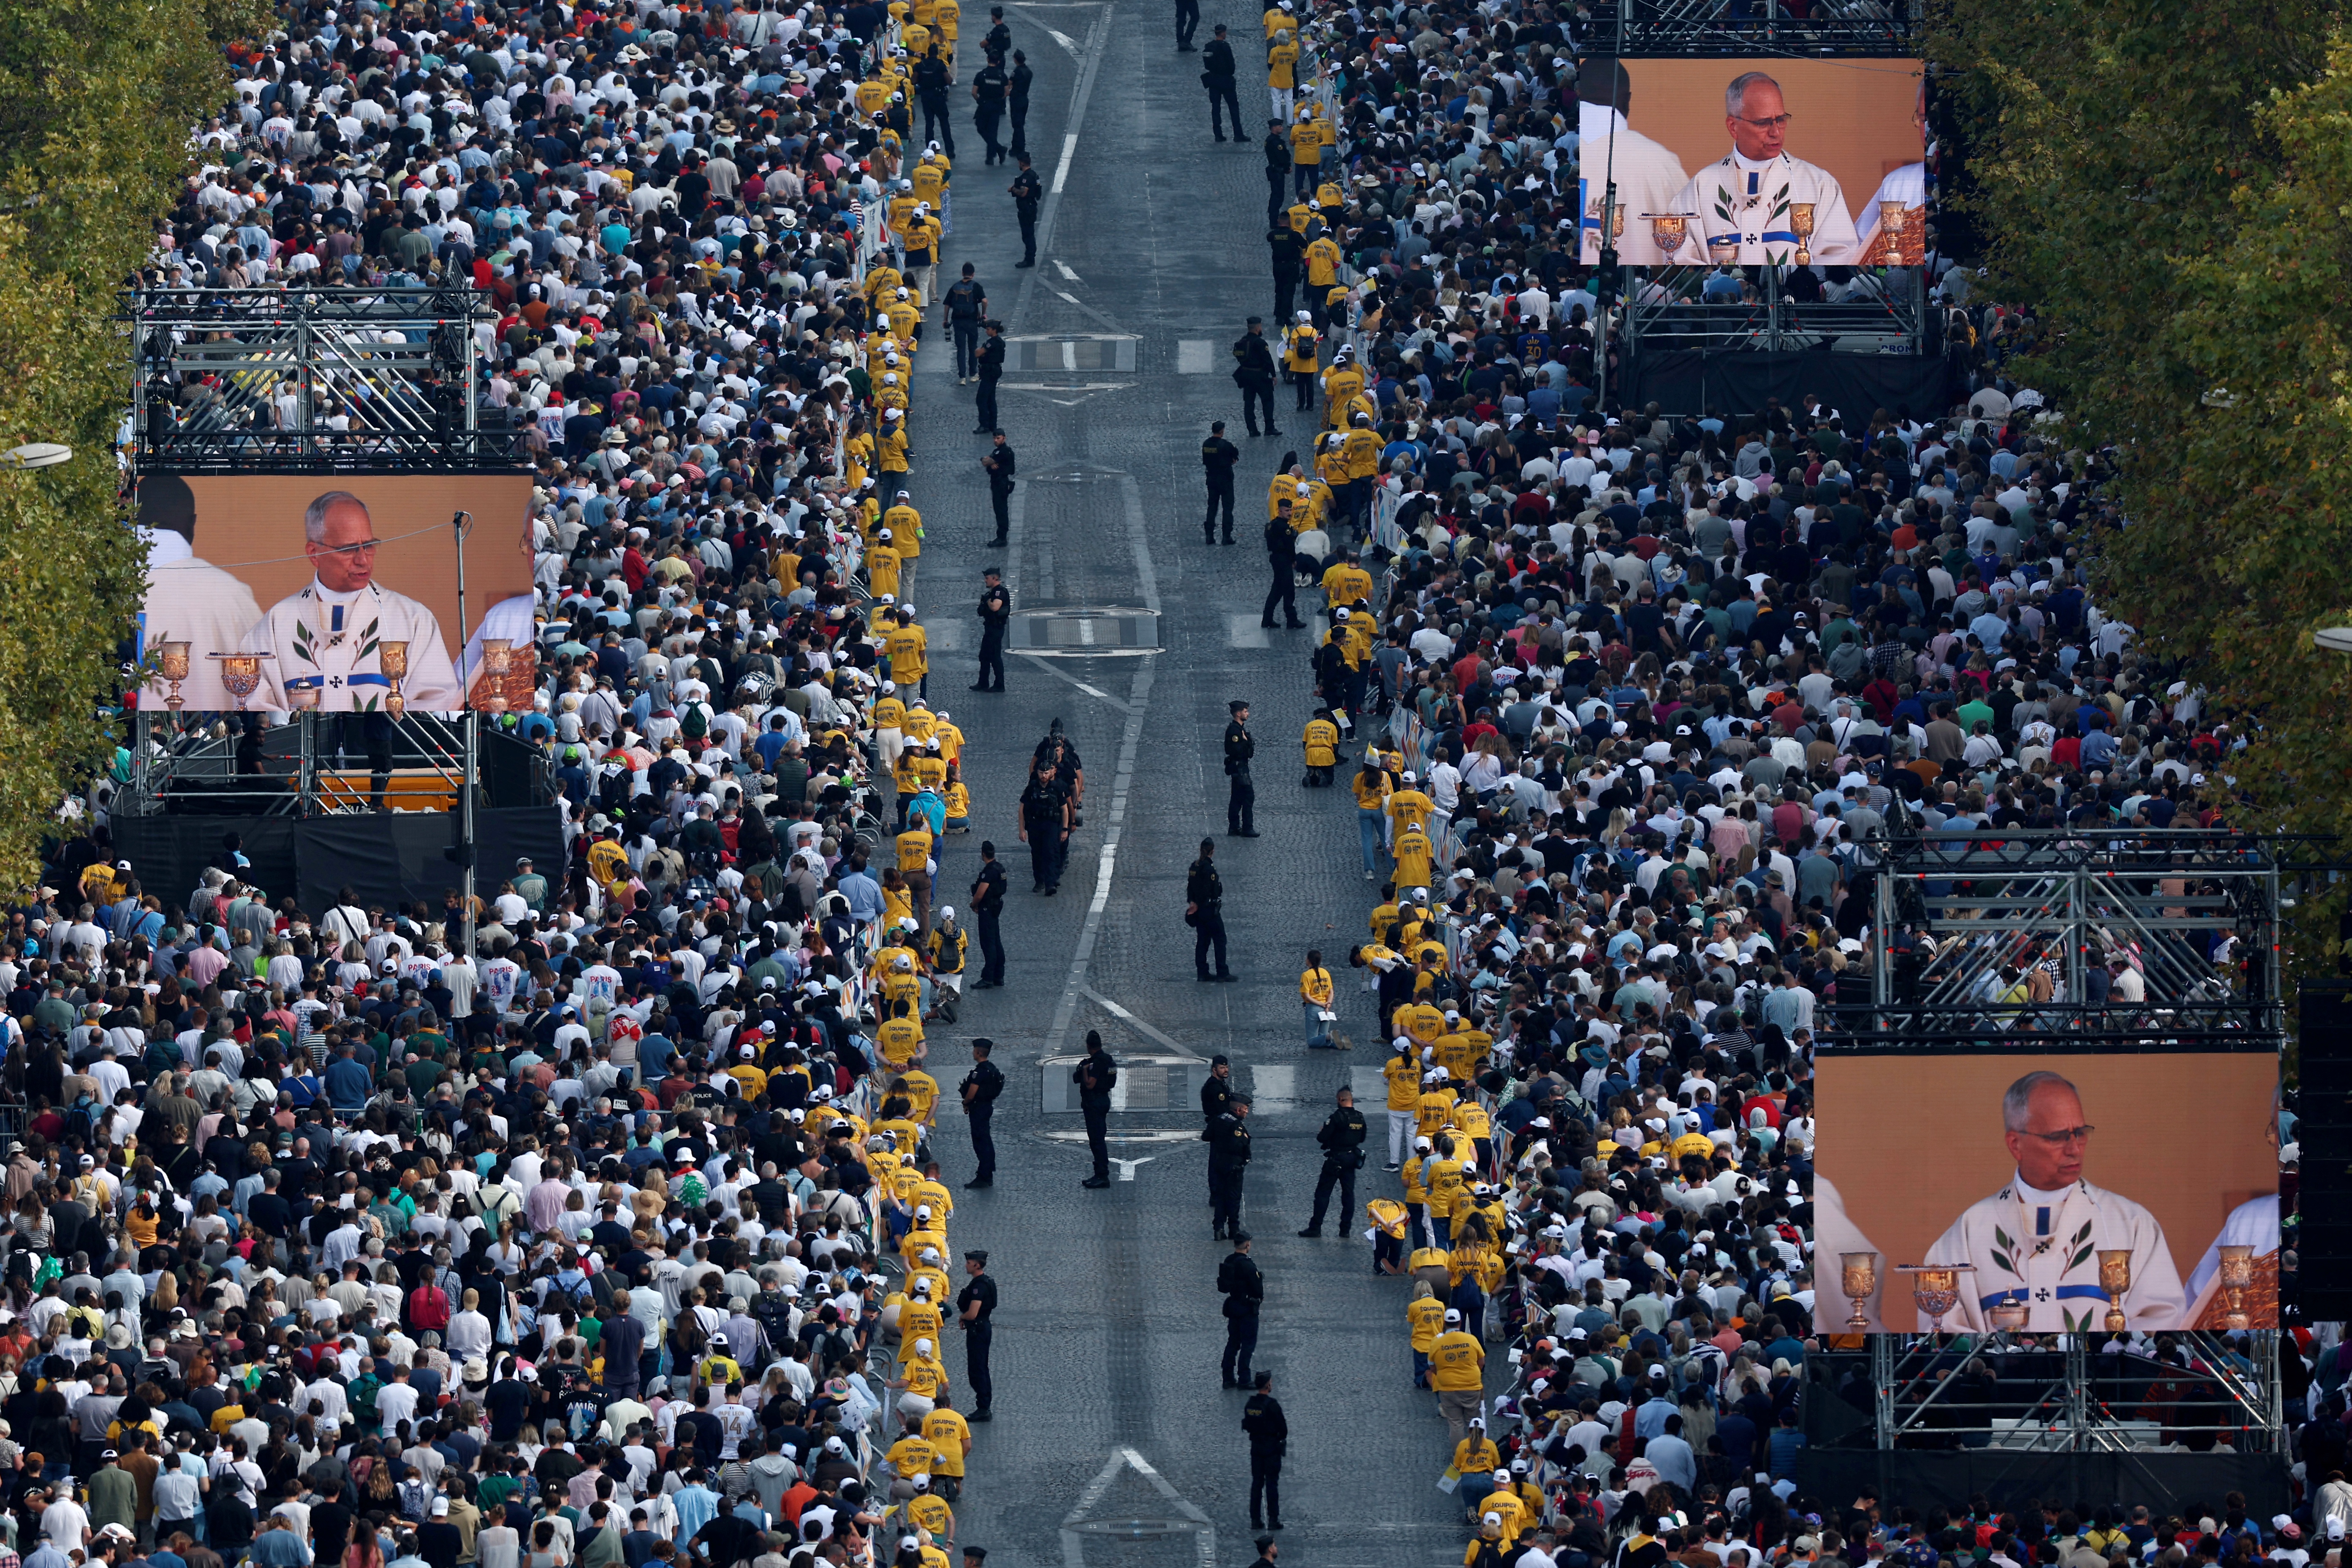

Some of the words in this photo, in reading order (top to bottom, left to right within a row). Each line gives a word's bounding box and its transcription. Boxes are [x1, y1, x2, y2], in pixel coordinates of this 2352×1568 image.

[1526, 346, 1542, 359] 30
[2032, 727, 2049, 742] 14
[903, 839, 926, 847] ÉQUIPIER
[596, 846, 618, 855] ÉQUIPIER
[489, 966, 513, 974] PARIS
[670, 1405, 690, 1421] 14
[721, 1416, 741, 1435] 14
